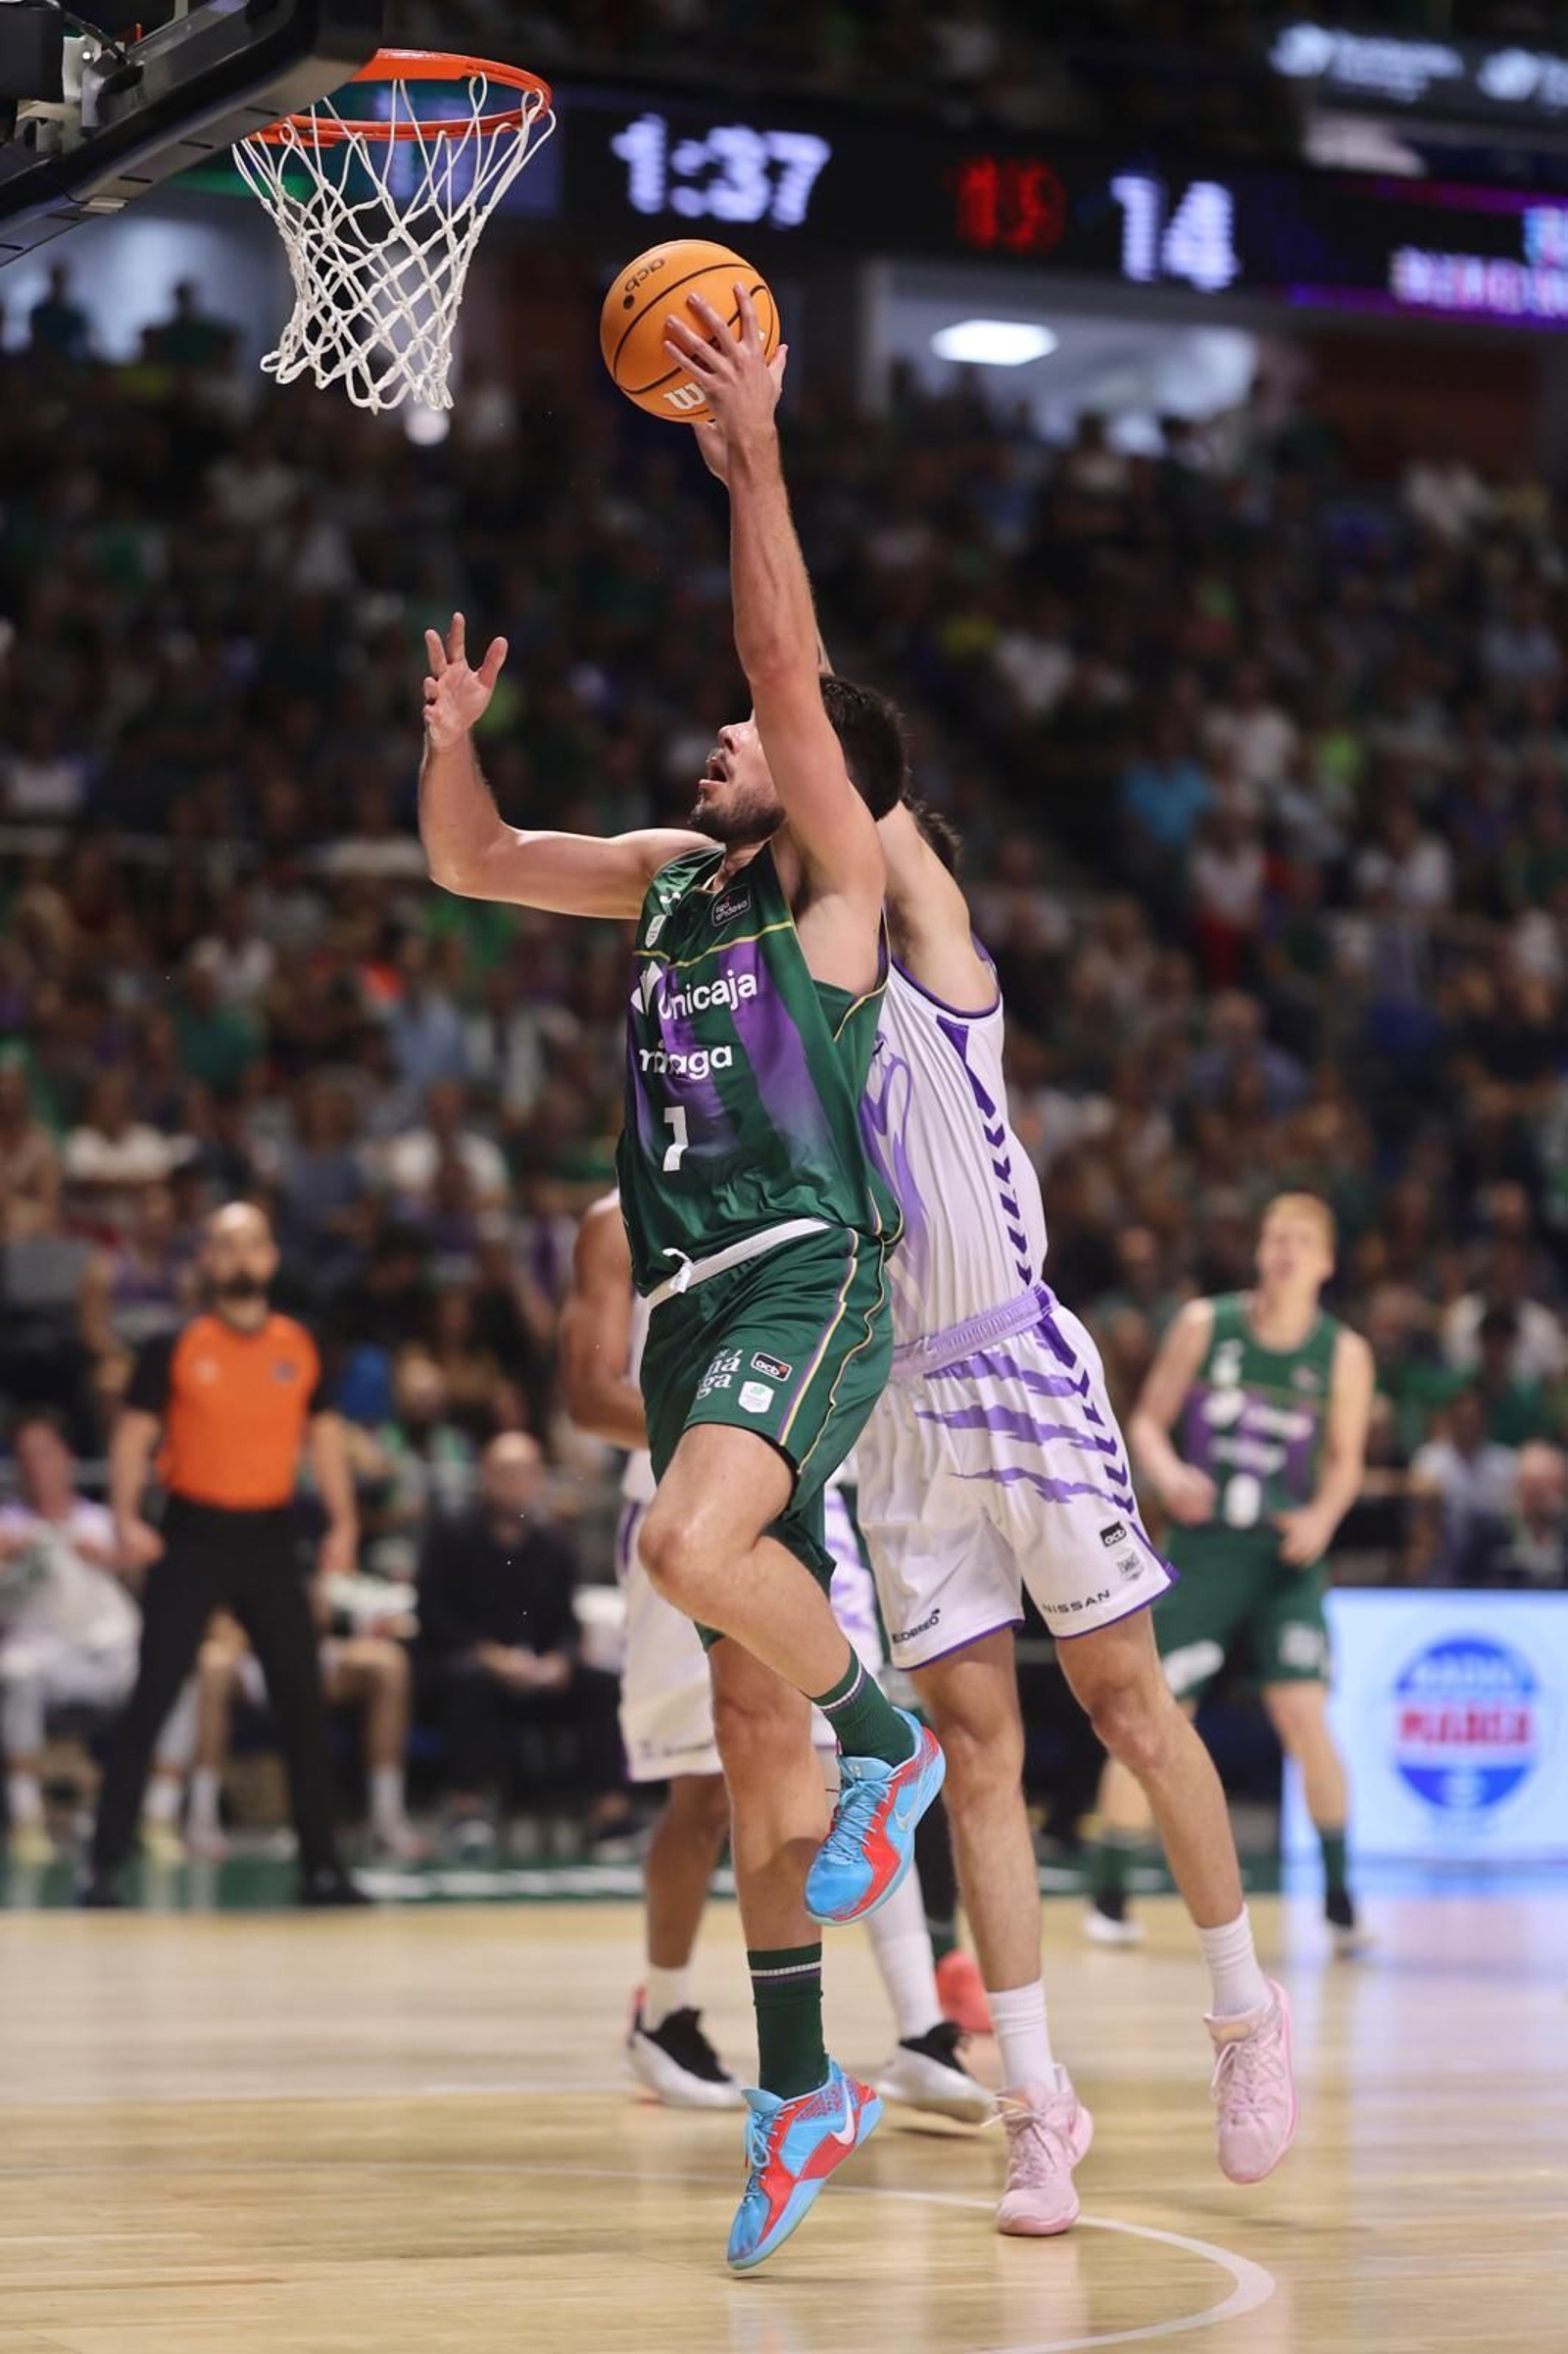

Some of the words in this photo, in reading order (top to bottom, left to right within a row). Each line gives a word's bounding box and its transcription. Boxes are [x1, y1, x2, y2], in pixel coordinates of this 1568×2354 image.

[612, 114, 831, 227] 1:37
[1109, 175, 1239, 290] 14
[624, 258, 666, 293] acb
[1042, 1589, 1110, 1614] NISSAN
